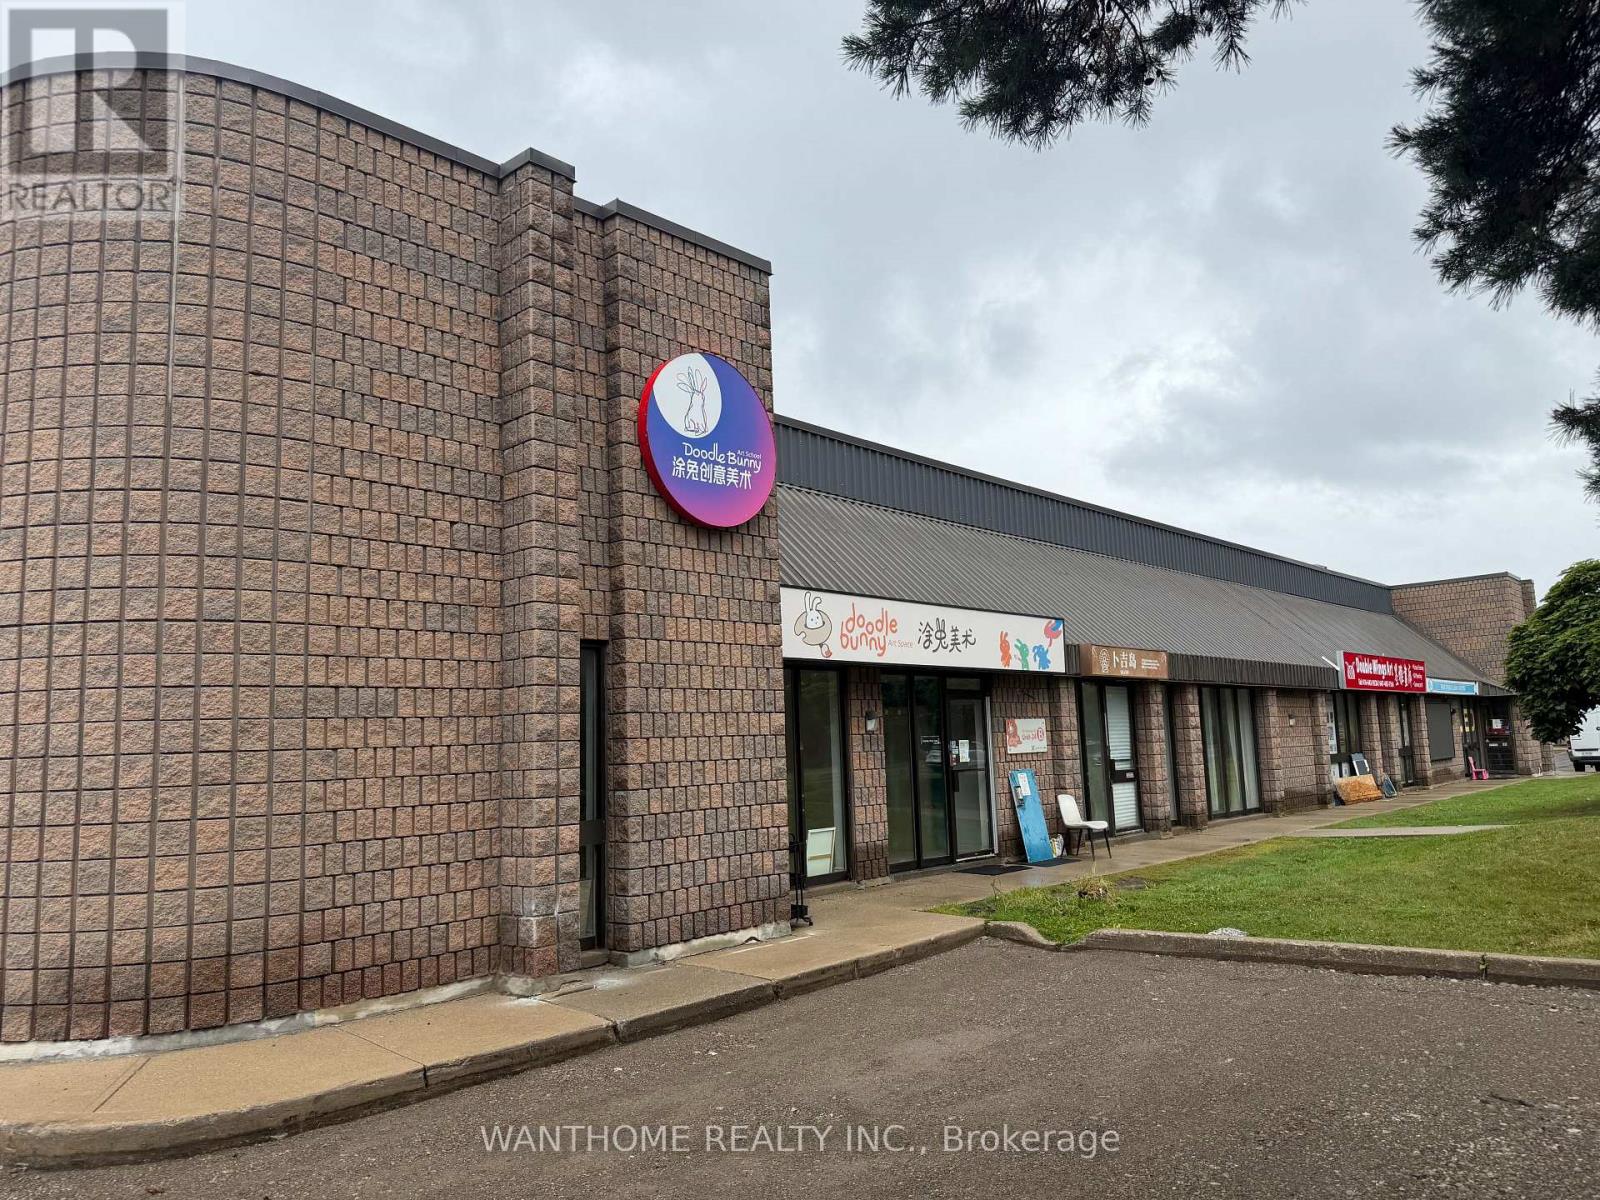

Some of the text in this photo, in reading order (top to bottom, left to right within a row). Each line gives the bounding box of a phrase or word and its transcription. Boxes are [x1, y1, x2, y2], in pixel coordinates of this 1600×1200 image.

[682, 442, 762, 473] Doodle Bunny
[745, 451, 762, 460] School
[845, 602, 898, 636] doodle
[840, 621, 887, 657] bunny
[898, 640, 914, 648] Space
